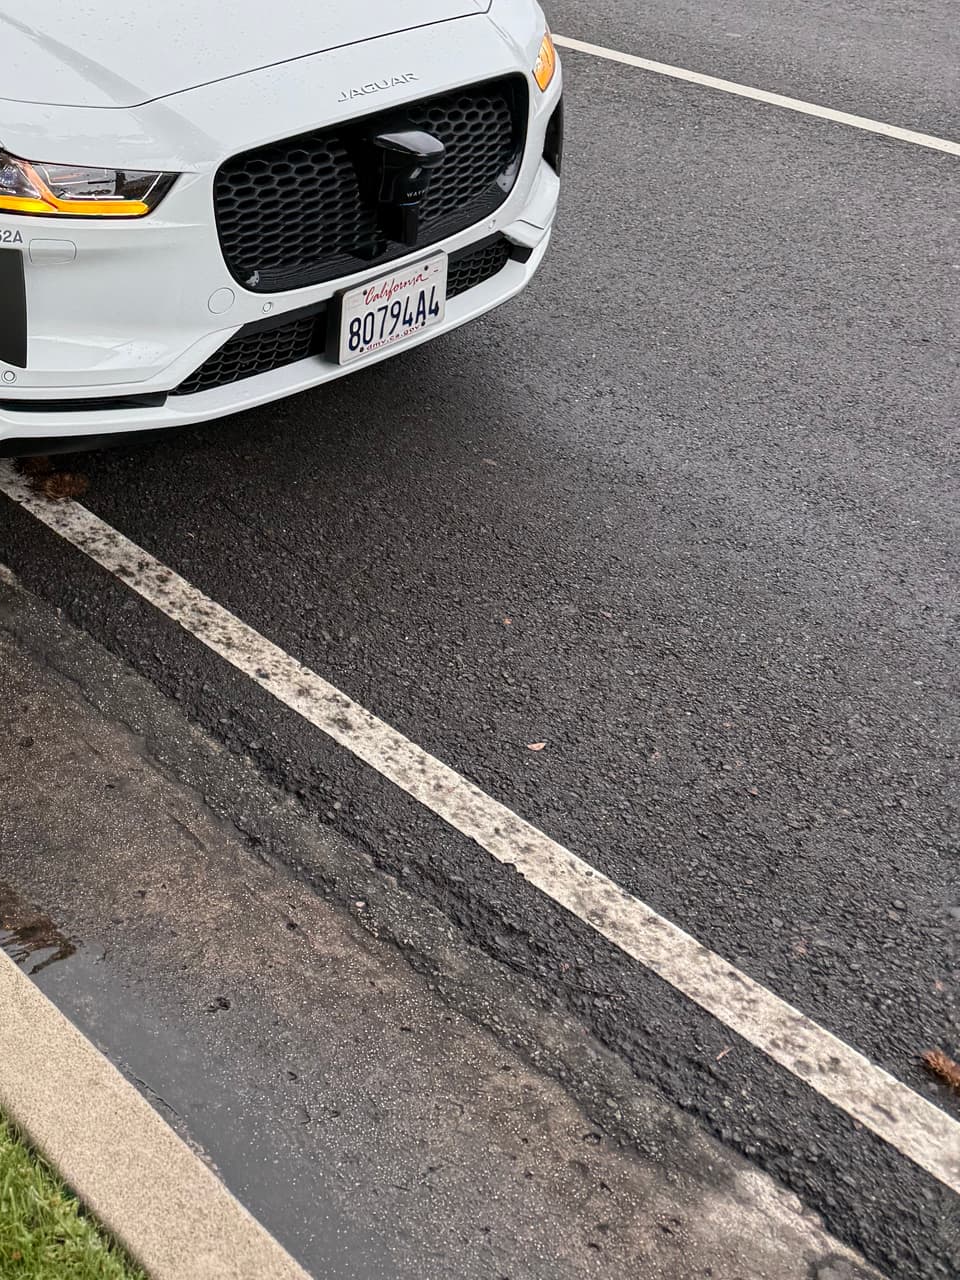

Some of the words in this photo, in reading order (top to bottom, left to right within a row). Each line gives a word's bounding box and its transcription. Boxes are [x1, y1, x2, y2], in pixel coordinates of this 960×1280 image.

[337, 72, 419, 102] JAGUAR
[365, 273, 429, 305] California
[348, 285, 440, 351] 80794A4
[366, 323, 421, 350] dmv.ca.gov
